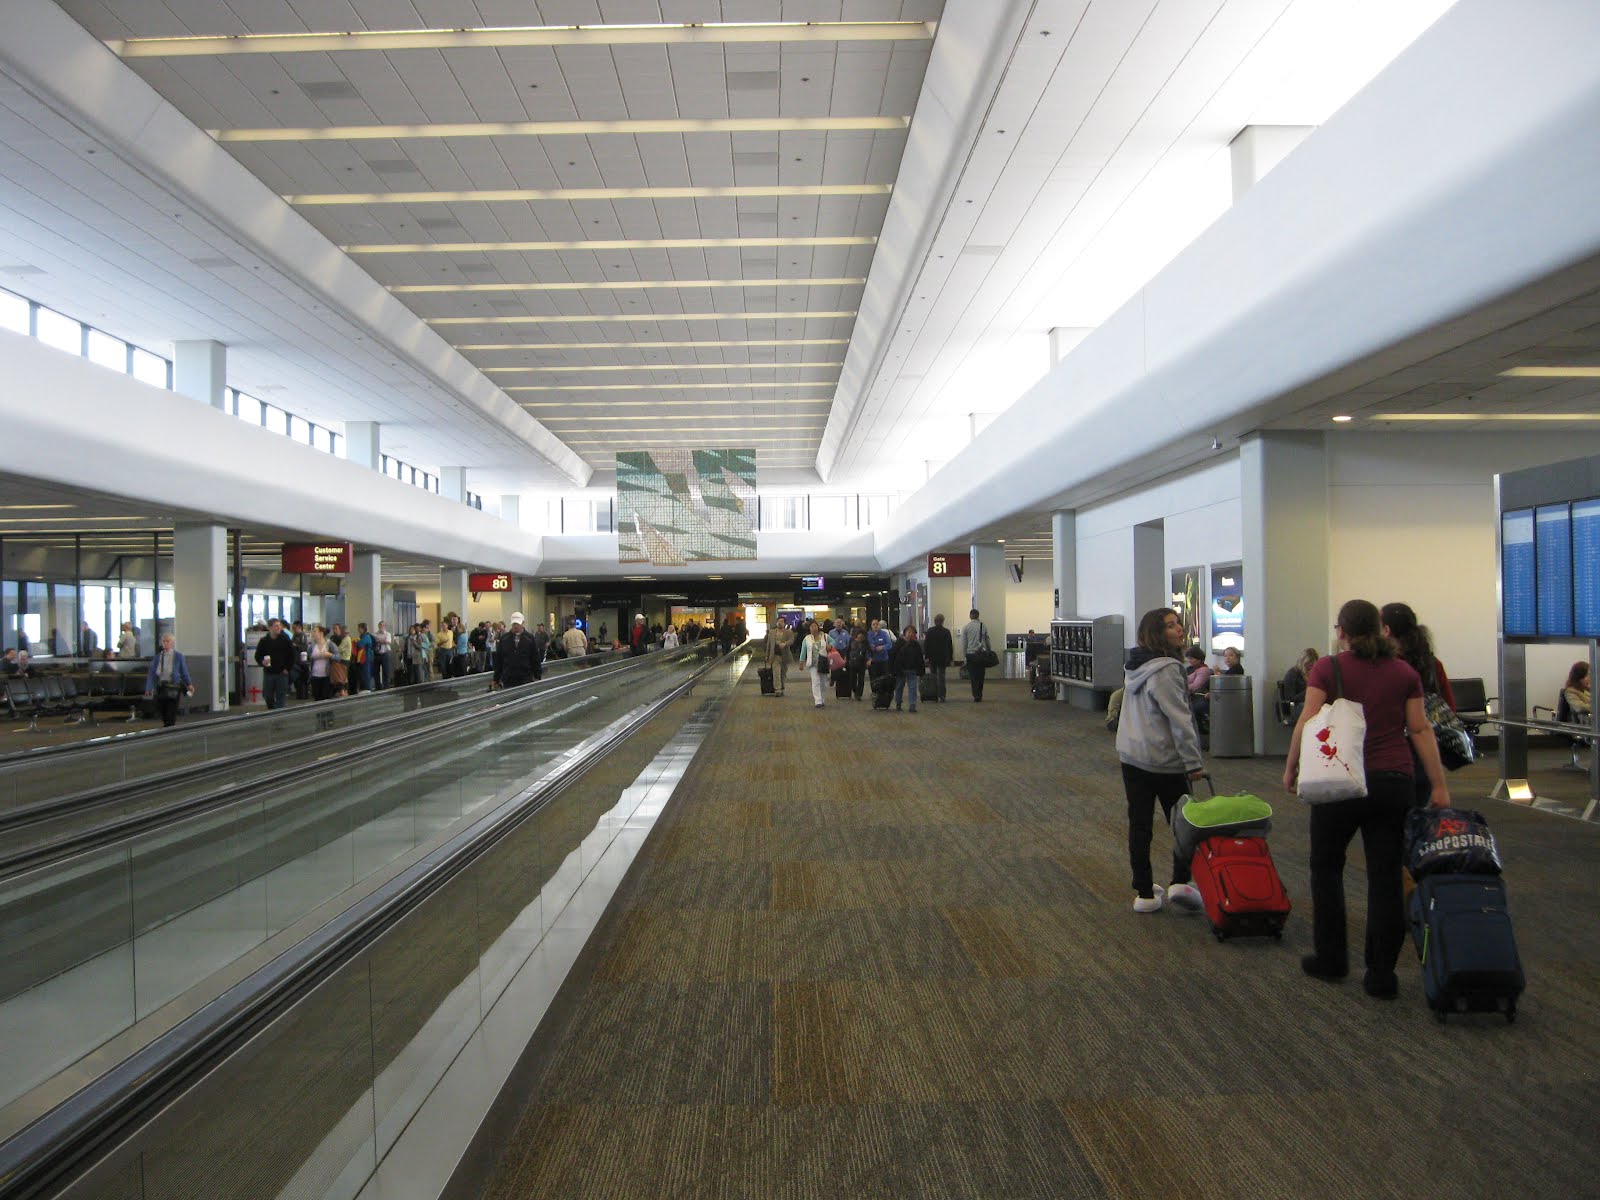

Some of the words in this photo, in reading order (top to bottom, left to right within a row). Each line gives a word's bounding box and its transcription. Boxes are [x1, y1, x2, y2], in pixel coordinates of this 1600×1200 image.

[314, 546, 343, 554] Customer
[933, 562, 946, 573] 81
[492, 579, 507, 589] 80
